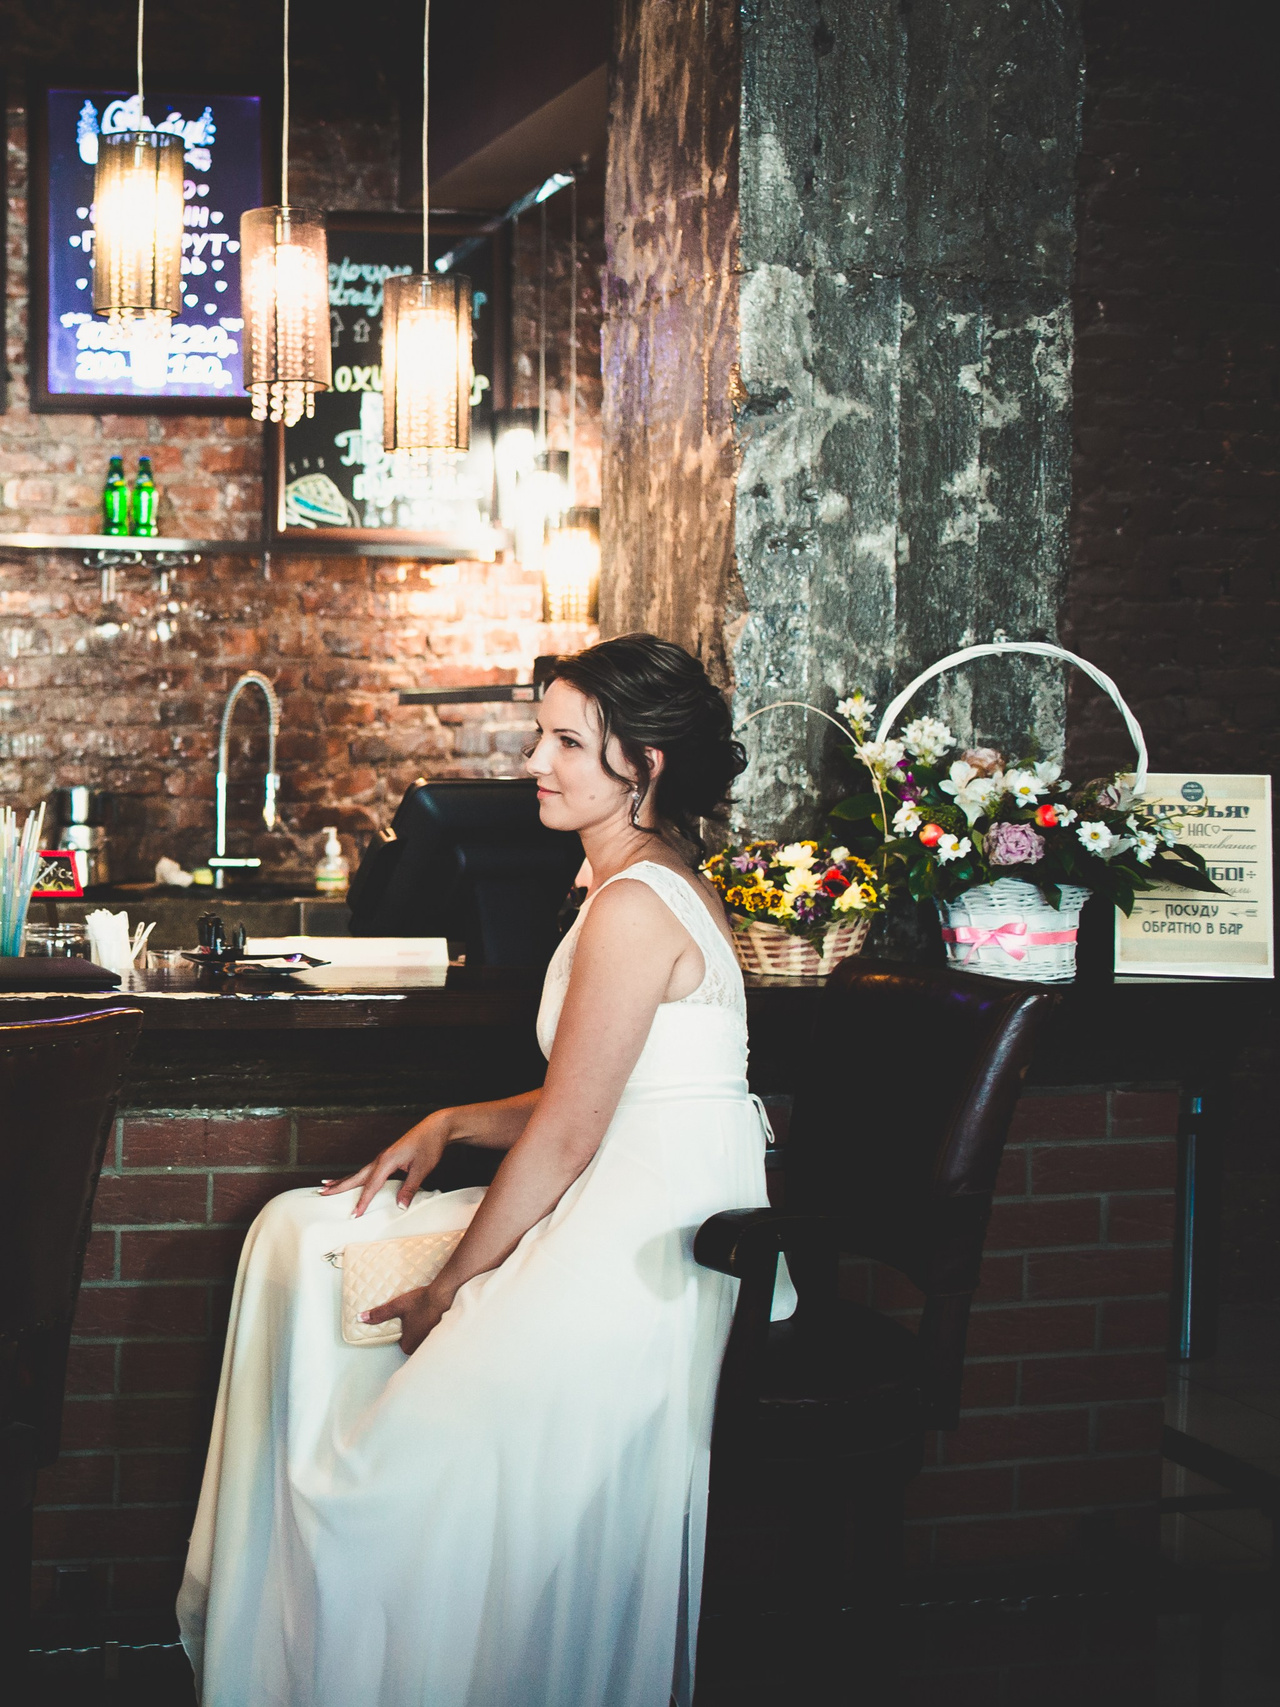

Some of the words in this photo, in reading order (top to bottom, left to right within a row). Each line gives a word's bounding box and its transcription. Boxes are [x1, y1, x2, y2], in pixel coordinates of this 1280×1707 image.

[1164, 904, 1219, 919] ПОСУДУ
[1142, 920, 1202, 934] ОБРАТНО
[1206, 922, 1215, 935] В
[1219, 922, 1244, 935] БАР
